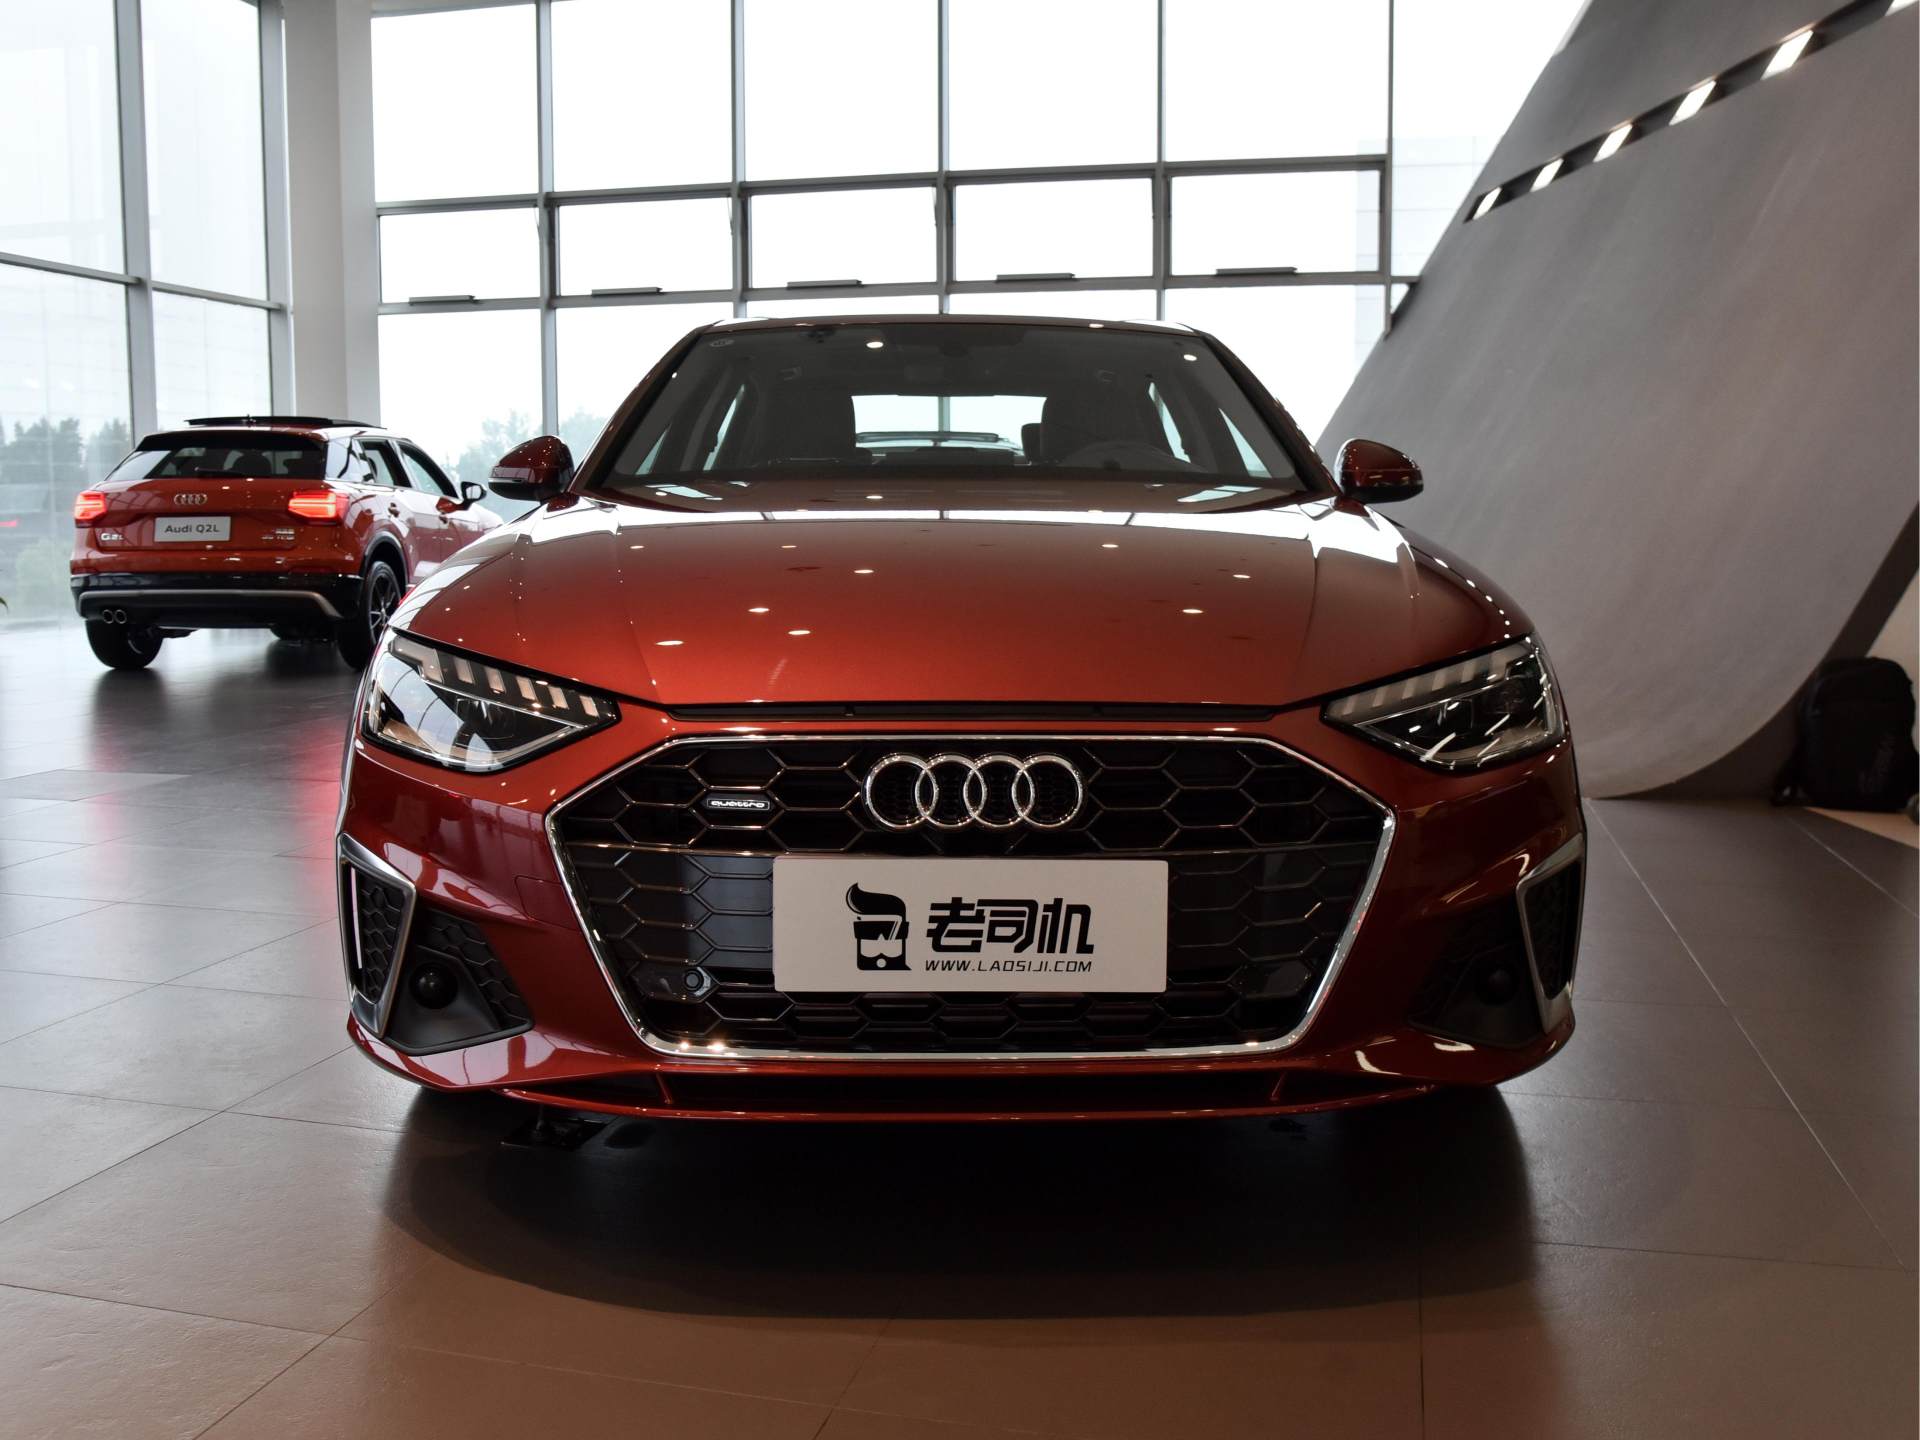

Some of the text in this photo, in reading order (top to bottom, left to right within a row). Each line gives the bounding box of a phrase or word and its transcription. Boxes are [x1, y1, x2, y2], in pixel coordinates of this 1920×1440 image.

[164, 524, 220, 534] Audi Q2L
[711, 800, 766, 809] quattro
[926, 897, 1095, 954] 老司机
[925, 960, 1093, 972] WWW.LAOSIJI.COM
